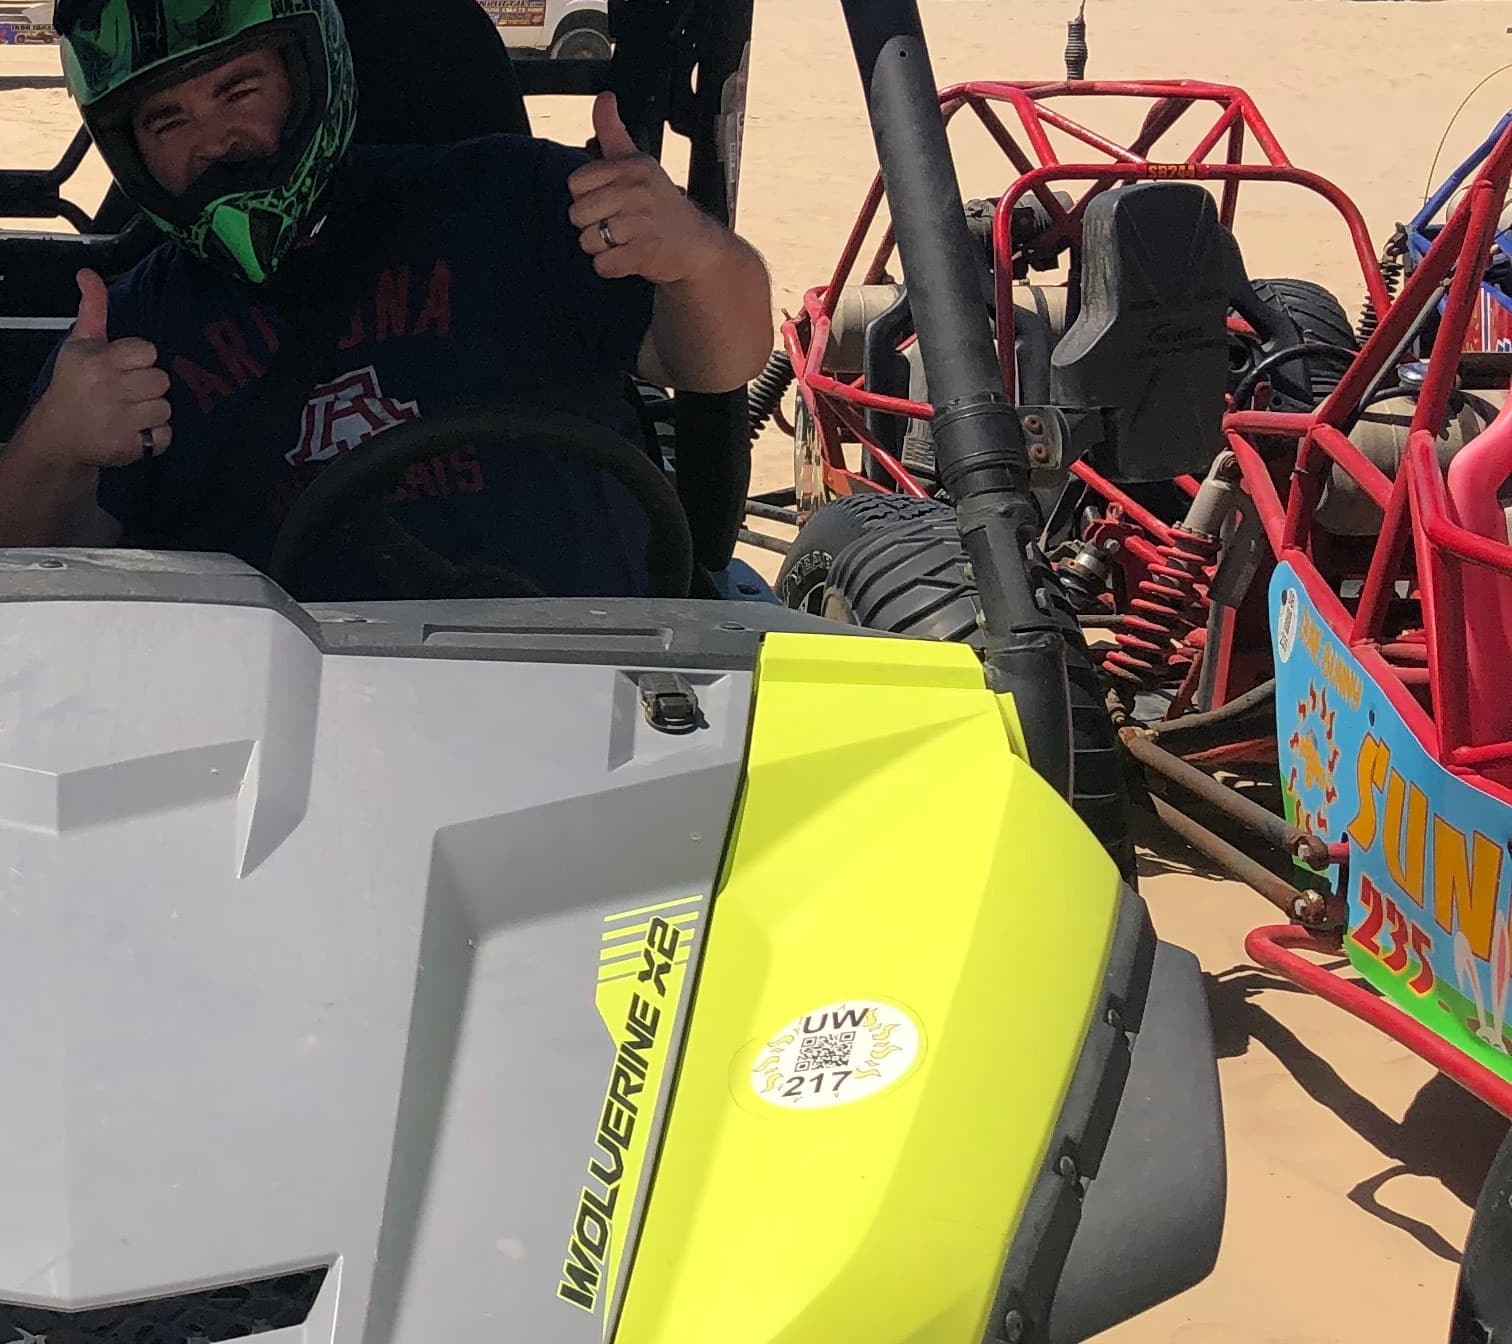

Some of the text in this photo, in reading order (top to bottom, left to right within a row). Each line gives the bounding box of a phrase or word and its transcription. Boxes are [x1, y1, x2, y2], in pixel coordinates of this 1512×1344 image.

[1351, 874, 1435, 997] 235
[802, 1007, 869, 1034] UW
[558, 917, 680, 1312] WOLVERINE X2
[781, 1070, 853, 1097] 217
